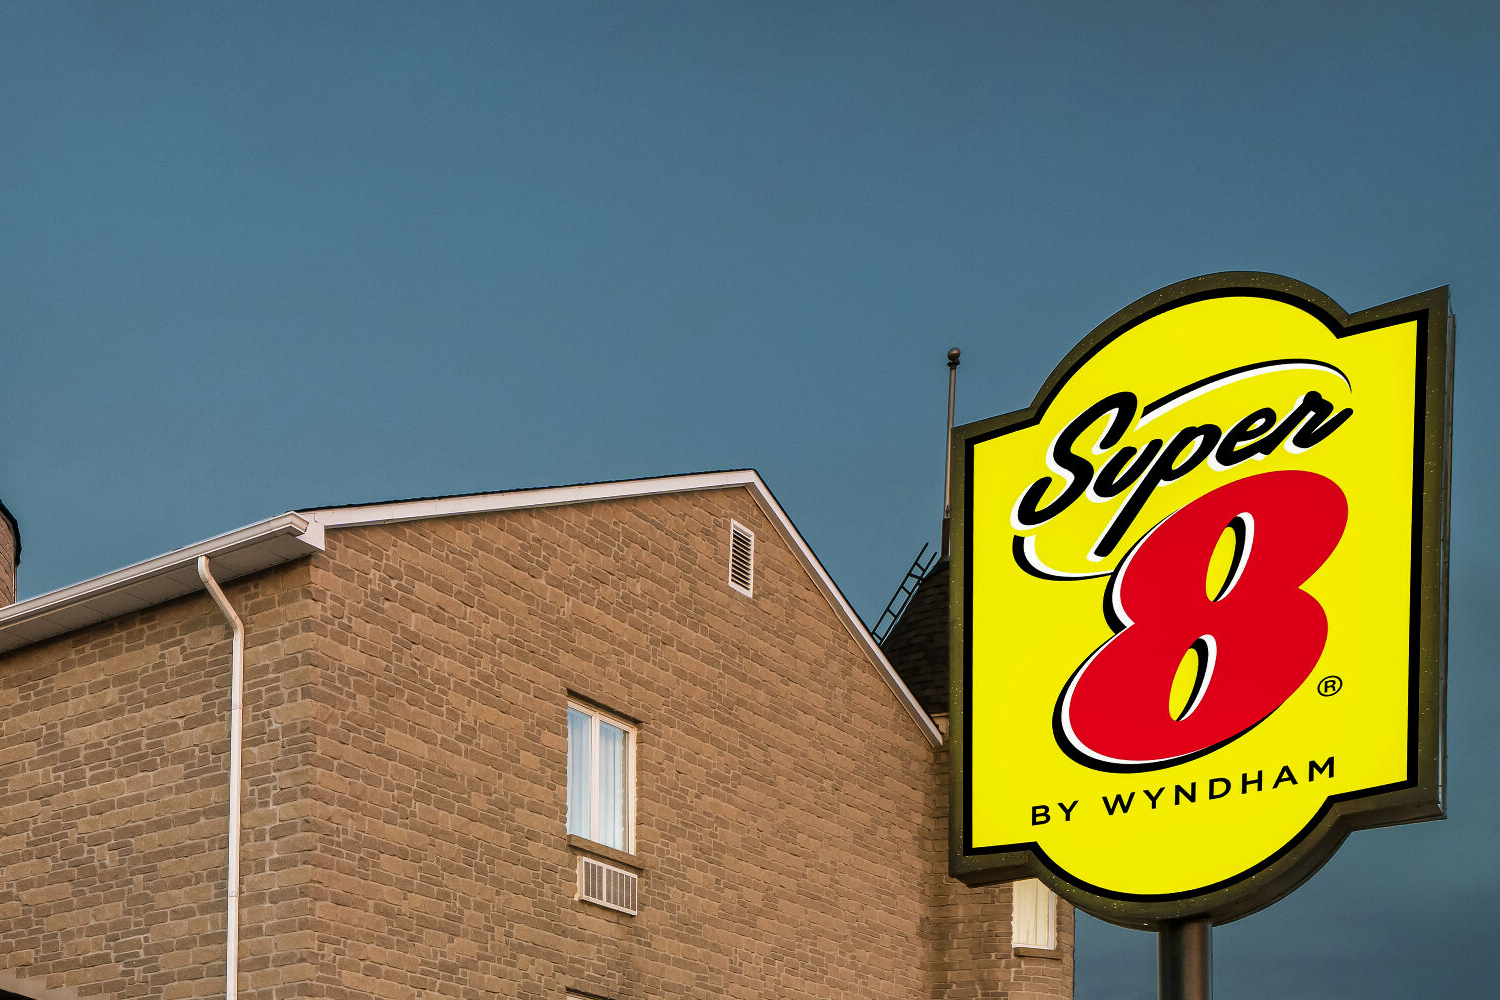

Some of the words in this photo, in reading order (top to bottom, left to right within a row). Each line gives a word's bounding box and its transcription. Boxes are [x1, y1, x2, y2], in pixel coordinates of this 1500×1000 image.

[1010, 385, 1354, 564] Super
[1052, 470, 1349, 774] 8
[1032, 800, 1079, 826] BY
[1102, 756, 1336, 816] WYNDHAM
